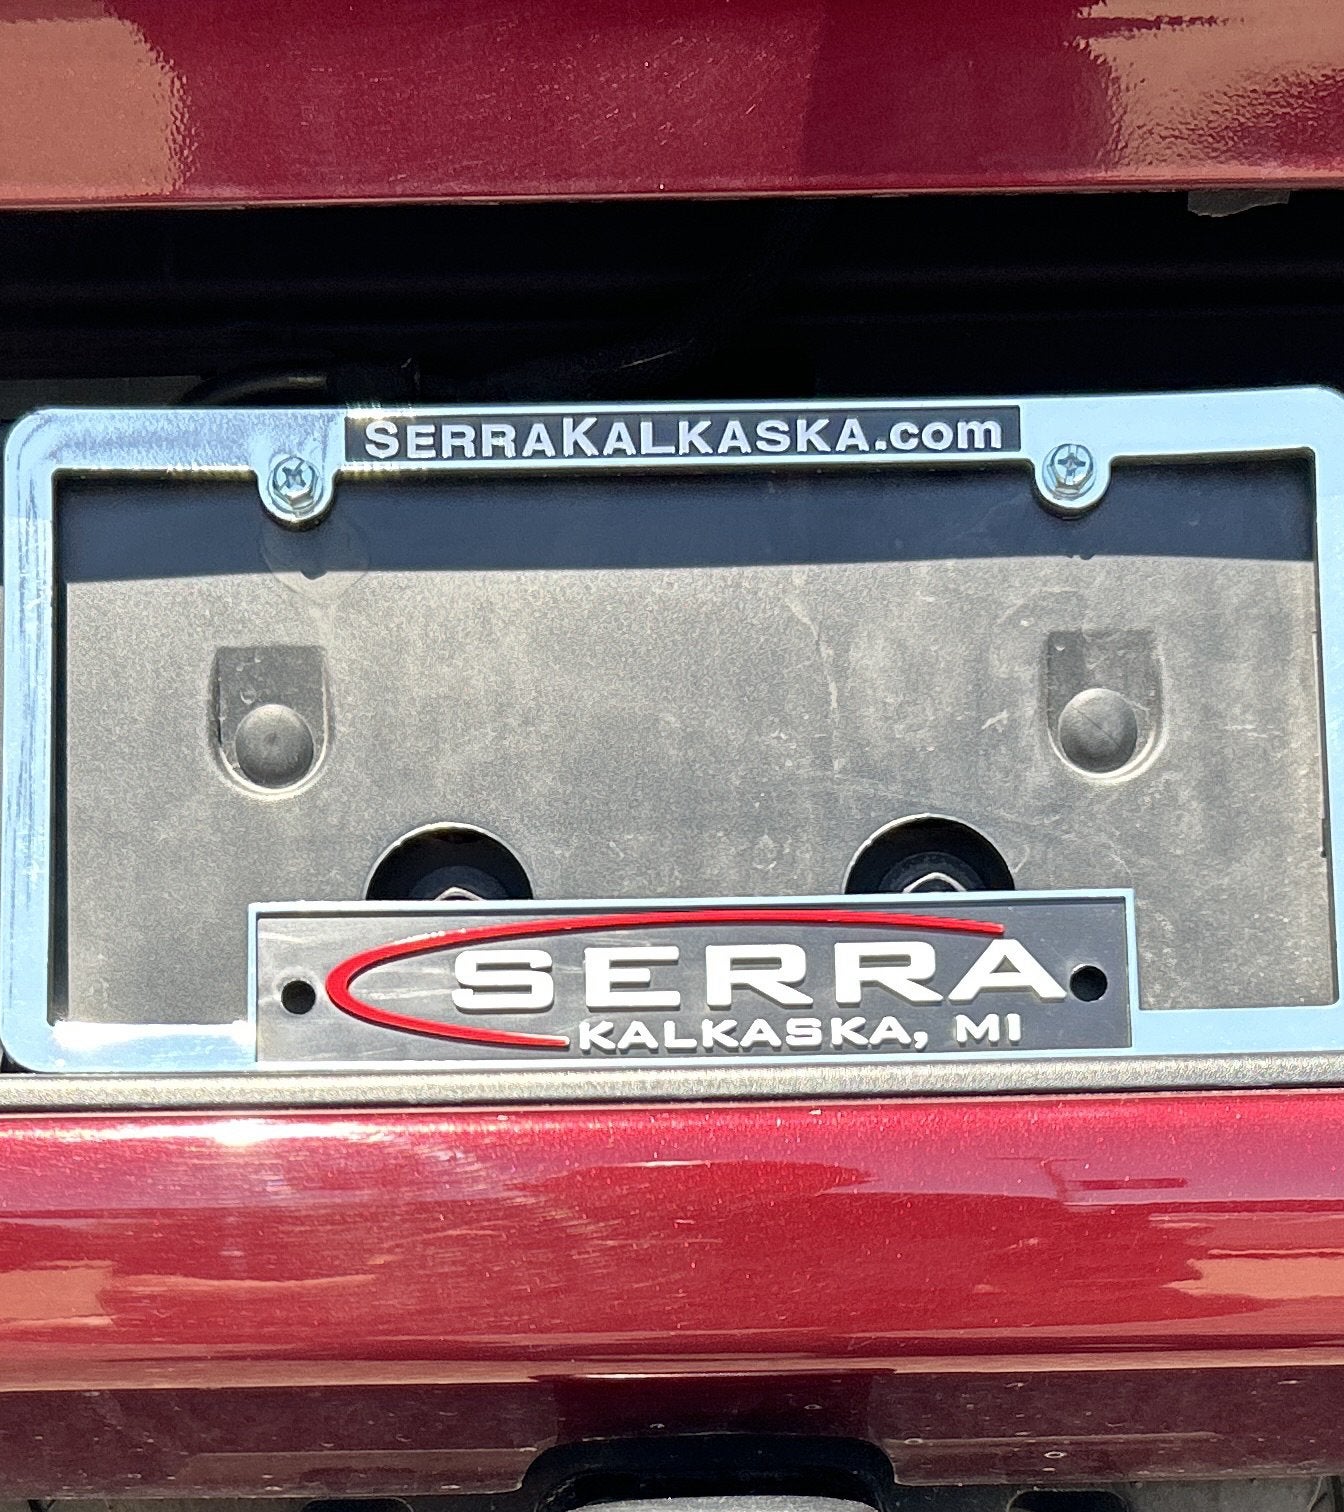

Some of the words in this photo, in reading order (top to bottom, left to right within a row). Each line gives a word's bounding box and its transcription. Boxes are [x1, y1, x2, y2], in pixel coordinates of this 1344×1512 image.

[452, 938, 1067, 1014] SERRA
[578, 1014, 928, 1051] KALKASKA,
[955, 1012, 1022, 1043] MI
